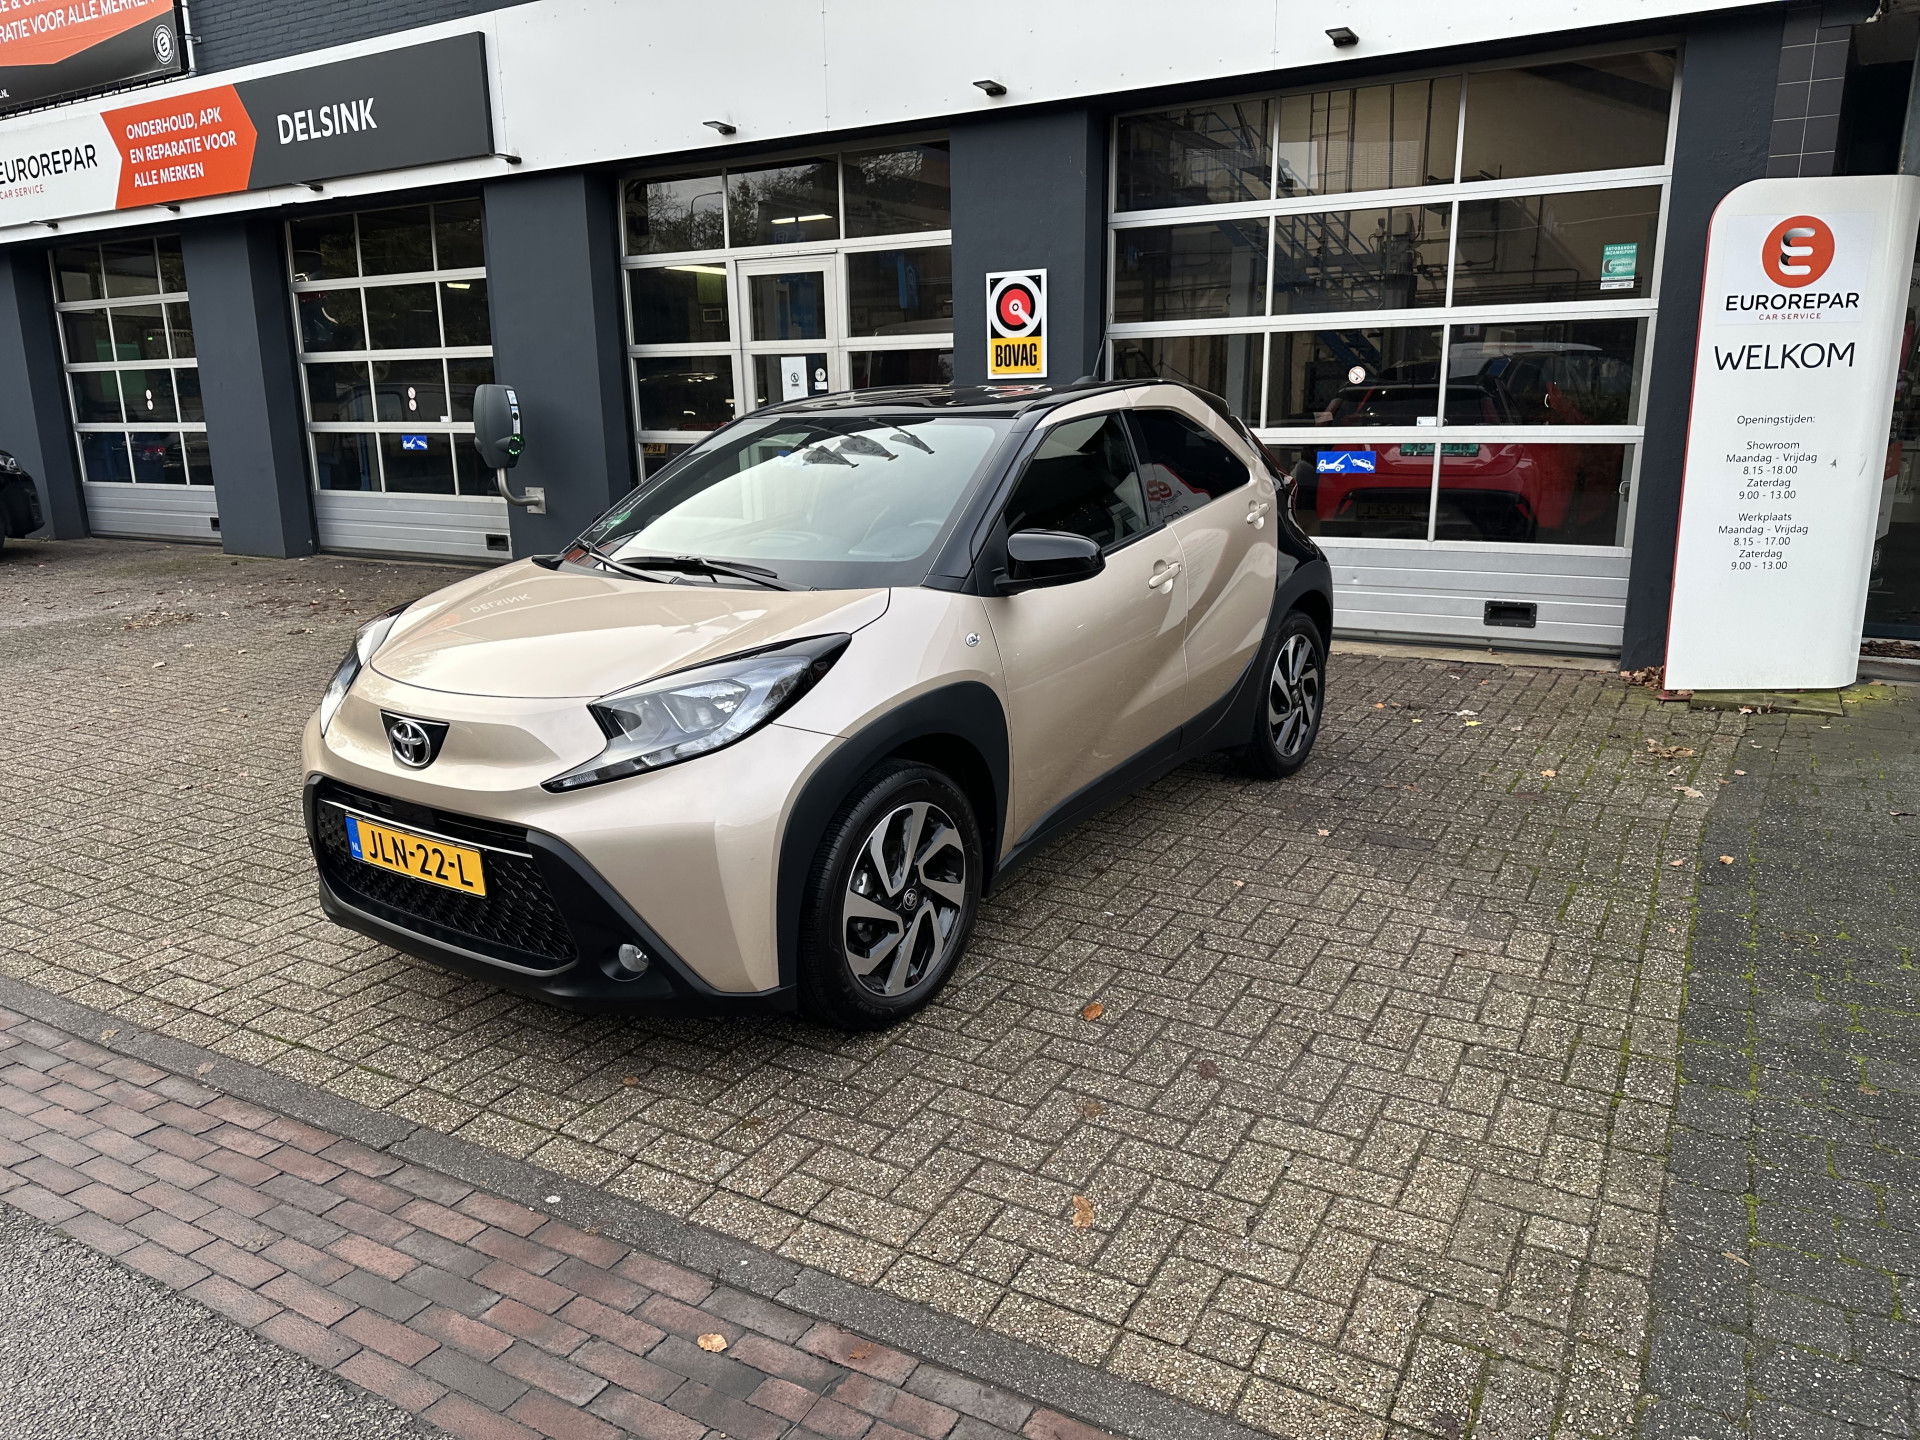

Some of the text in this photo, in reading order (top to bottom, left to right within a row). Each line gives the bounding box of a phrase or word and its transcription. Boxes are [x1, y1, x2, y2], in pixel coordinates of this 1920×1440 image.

[29, 10, 66, 34] VOOR
[68, 2, 99, 25] ALLE
[126, 107, 222, 140] ONDERHOUD, APK
[277, 98, 378, 145] DELSINK
[129, 130, 237, 164] EN REPARATIE VOOR
[134, 162, 204, 188] ALLE MERKEN
[15, 184, 44, 197] SERVICE
[1725, 292, 1860, 311] EUROREPAR
[1758, 312, 1821, 321] CAR SERVICE
[995, 343, 1037, 367] BOVAG
[1714, 342, 1856, 371] WELKOM
[1736, 414, 1816, 426] Openingstijden:
[1746, 440, 1800, 450] Showroom
[1726, 453, 1772, 464] Maandag
[1783, 452, 1818, 464] Vrijdag
[1743, 466, 1763, 475] 8.15
[1746, 478, 1791, 489] Zaterdag
[1739, 491, 1759, 500] 9.00
[1770, 490, 1796, 499] 13.00
[1738, 512, 1792, 523] Werkplaats
[1718, 524, 1764, 535] Maandag
[1774, 524, 1809, 535] Vrijdag
[1733, 537, 1754, 546] 8.15
[1764, 536, 1791, 546] 17.00
[1739, 549, 1782, 560] Zaterdag
[1731, 561, 1751, 571] 9.00
[1762, 561, 1788, 570] 13.00
[369, 830, 474, 887] JLN-22-L
